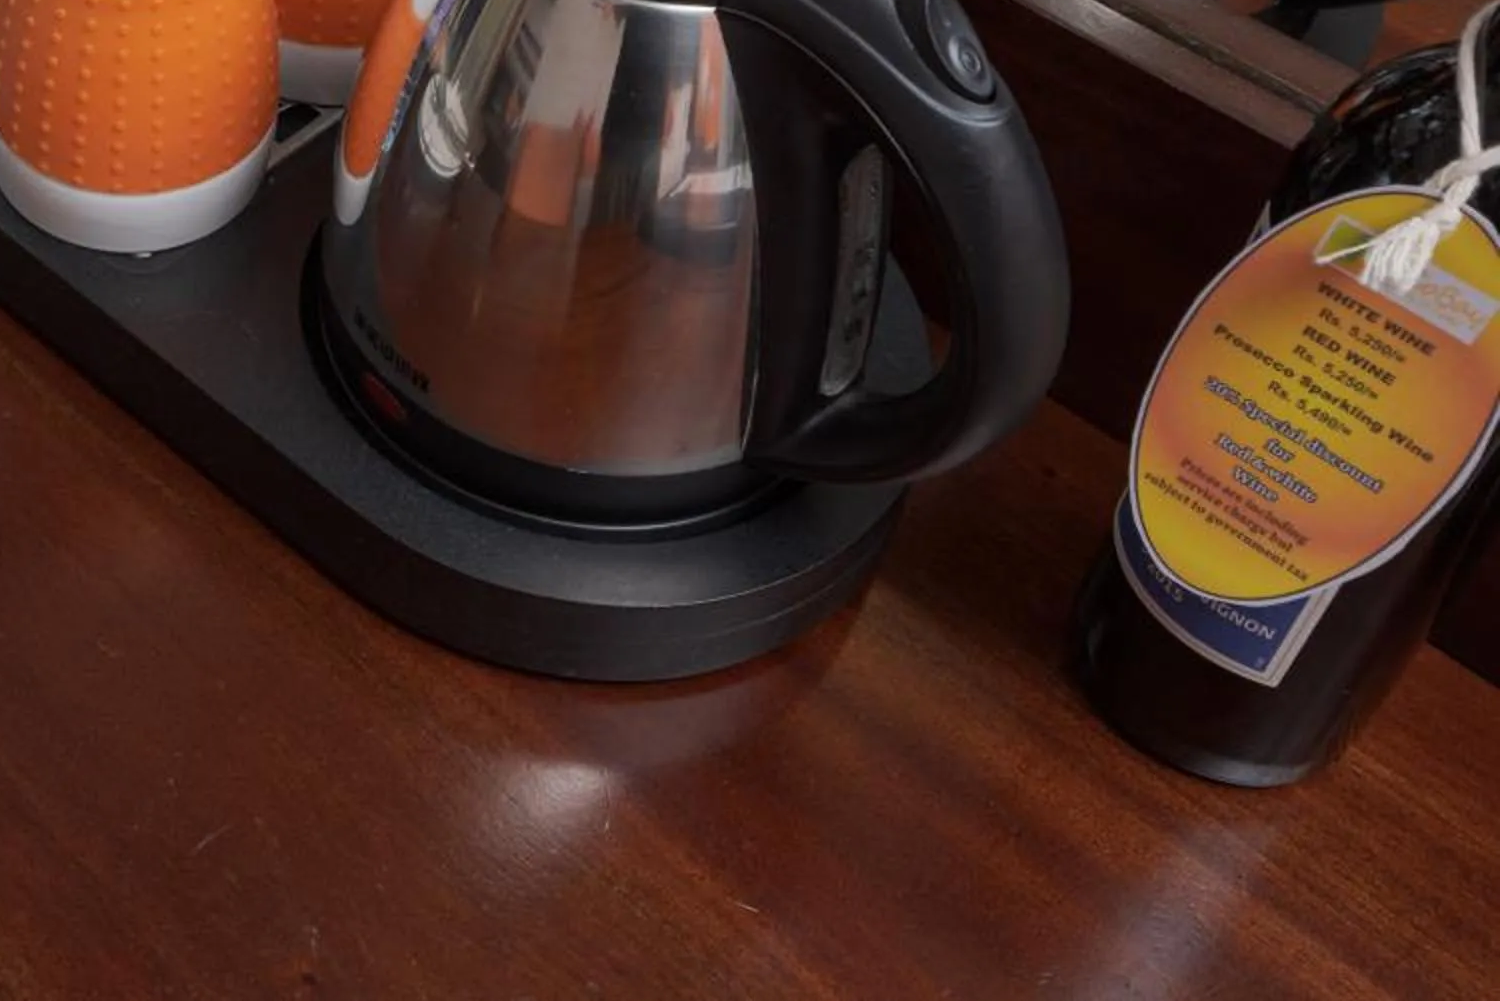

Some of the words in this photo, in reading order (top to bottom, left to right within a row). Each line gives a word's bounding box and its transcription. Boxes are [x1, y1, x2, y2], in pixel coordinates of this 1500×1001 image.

[1318, 281, 1382, 323] WHITE
[1384, 318, 1437, 356] WINE
[1319, 307, 1341, 329] Rs.
[1293, 344, 1316, 367] Rs.
[1303, 325, 1341, 353] RED
[1345, 349, 1397, 386] WINE
[1214, 323, 1296, 379] Prosecco
[1300, 375, 1385, 434] Sparkling
[1387, 427, 1434, 462] Wine
[1268, 380, 1290, 402] Rs.
[1214, 432, 1254, 462] Red
[1240, 398, 1307, 444] Special
[1304, 436, 1385, 495] discount
[1264, 438, 1296, 463] for
[1232, 466, 1280, 503] Wine
[1144, 471, 1191, 510] subject
[1190, 501, 1207, 515] to
[1204, 513, 1288, 569] government
[1177, 474, 1223, 507] service
[1222, 502, 1267, 537] charge
[1269, 531, 1294, 552] but
